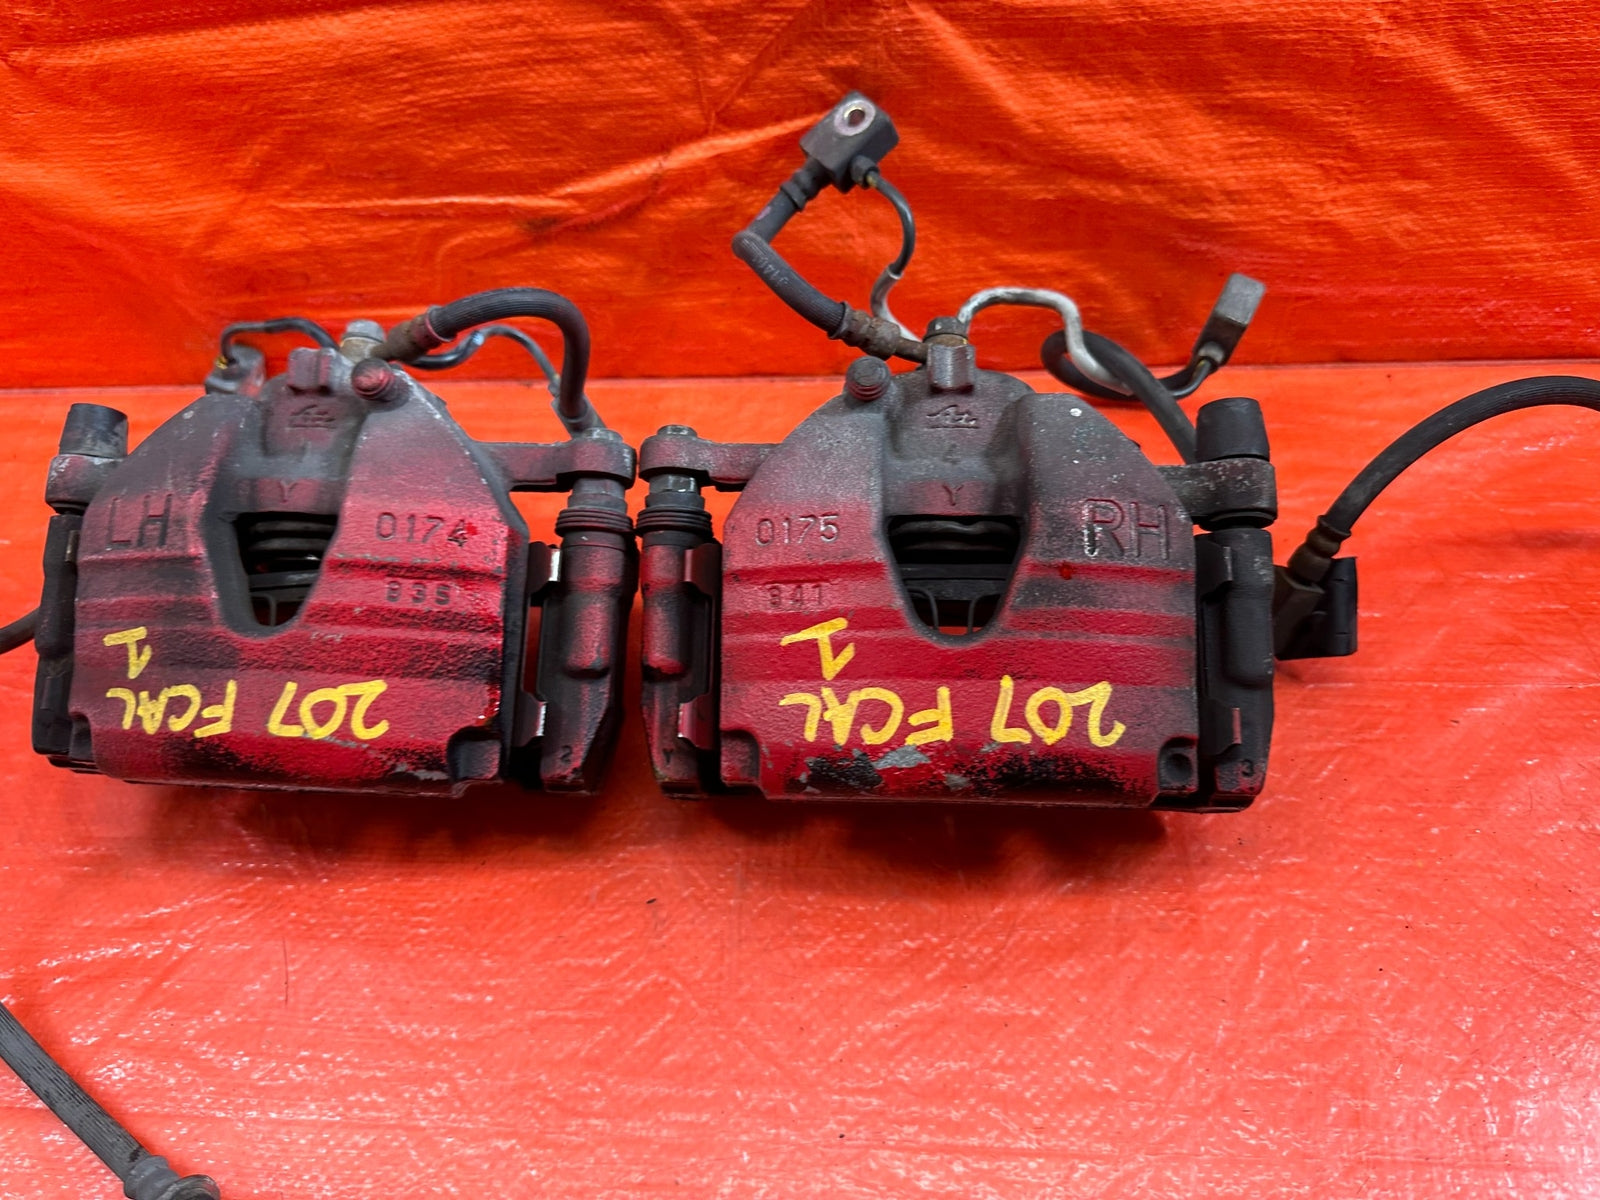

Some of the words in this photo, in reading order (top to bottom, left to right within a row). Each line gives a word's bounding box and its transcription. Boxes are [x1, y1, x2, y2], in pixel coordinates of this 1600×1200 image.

[106, 492, 172, 551] LH
[376, 511, 467, 547] 0174
[756, 512, 840, 547] 0175
[1081, 498, 1169, 560] RH
[103, 627, 151, 679] 1
[780, 617, 855, 680] 1
[266, 679, 390, 740] 207
[990, 674, 1126, 748] 207
